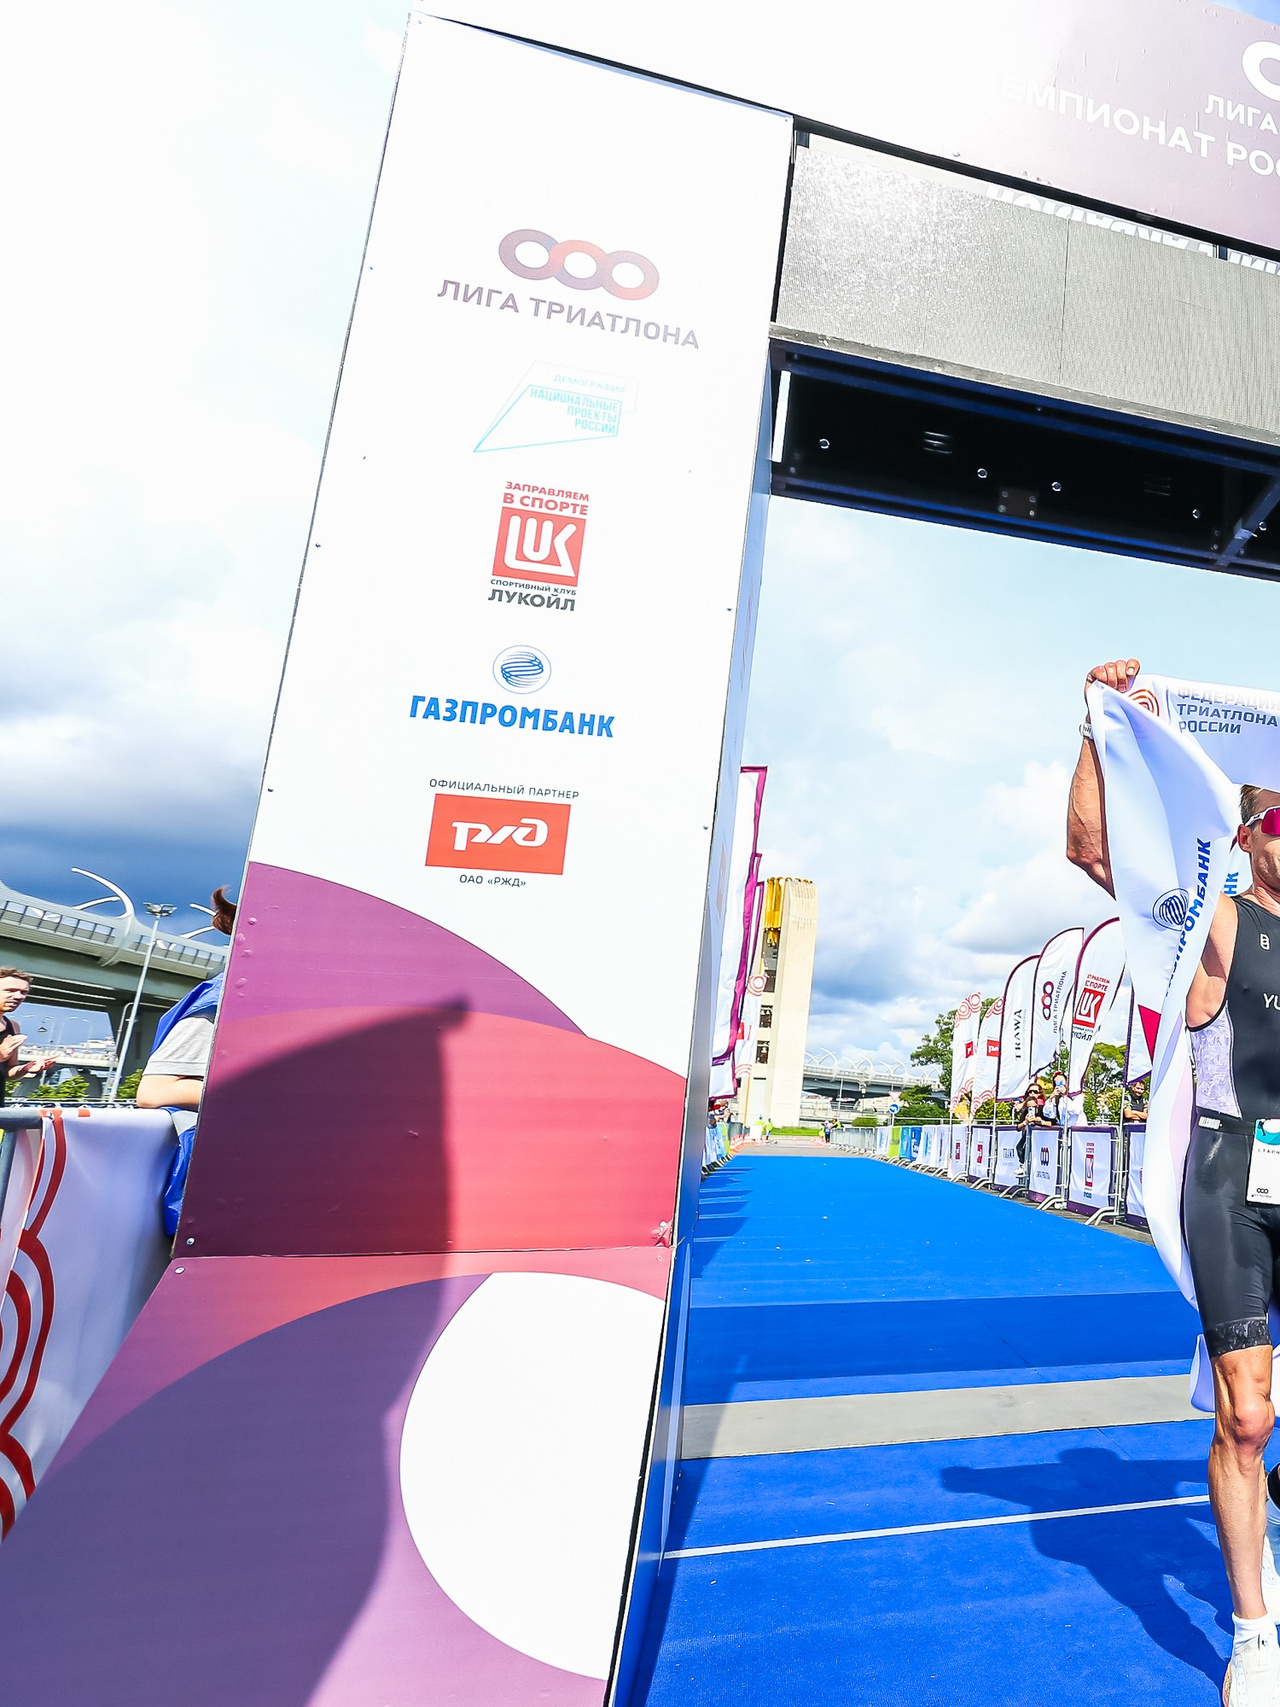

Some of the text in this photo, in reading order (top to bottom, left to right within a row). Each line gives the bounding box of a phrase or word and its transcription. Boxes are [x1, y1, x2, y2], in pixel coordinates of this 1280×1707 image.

[984, 69, 1216, 159] ЕМПИОНАТ
[1204, 93, 1279, 136] ЛИГА
[437, 279, 699, 349] ЛИГА ТРИАТЛОНА
[553, 374, 626, 394] ДЕМОГРАФИЯ
[529, 388, 618, 412] НАЦИОНАЛЬНЫЕ
[566, 405, 617, 424] ПРОЕКТЫ
[574, 418, 616, 434] РОССИИ
[505, 481, 589, 502] ЗАПРАВЛЯЕМ
[503, 492, 588, 516] В СПОРТЕ
[490, 579, 577, 595] СПОРТИВНЫЙ КЛУБ
[488, 588, 576, 612] ЛУКОЙЛ
[409, 695, 615, 738] ГАЗПРОМБАНК
[1177, 703, 1278, 727] ТРИАТЛОНА
[1179, 720, 1241, 734] РОССИИ
[429, 778, 580, 800] ОФИЦИАЛЬНЫЙ ПАРТНЕР
[459, 874, 526, 888] ОАО «РЖД»
